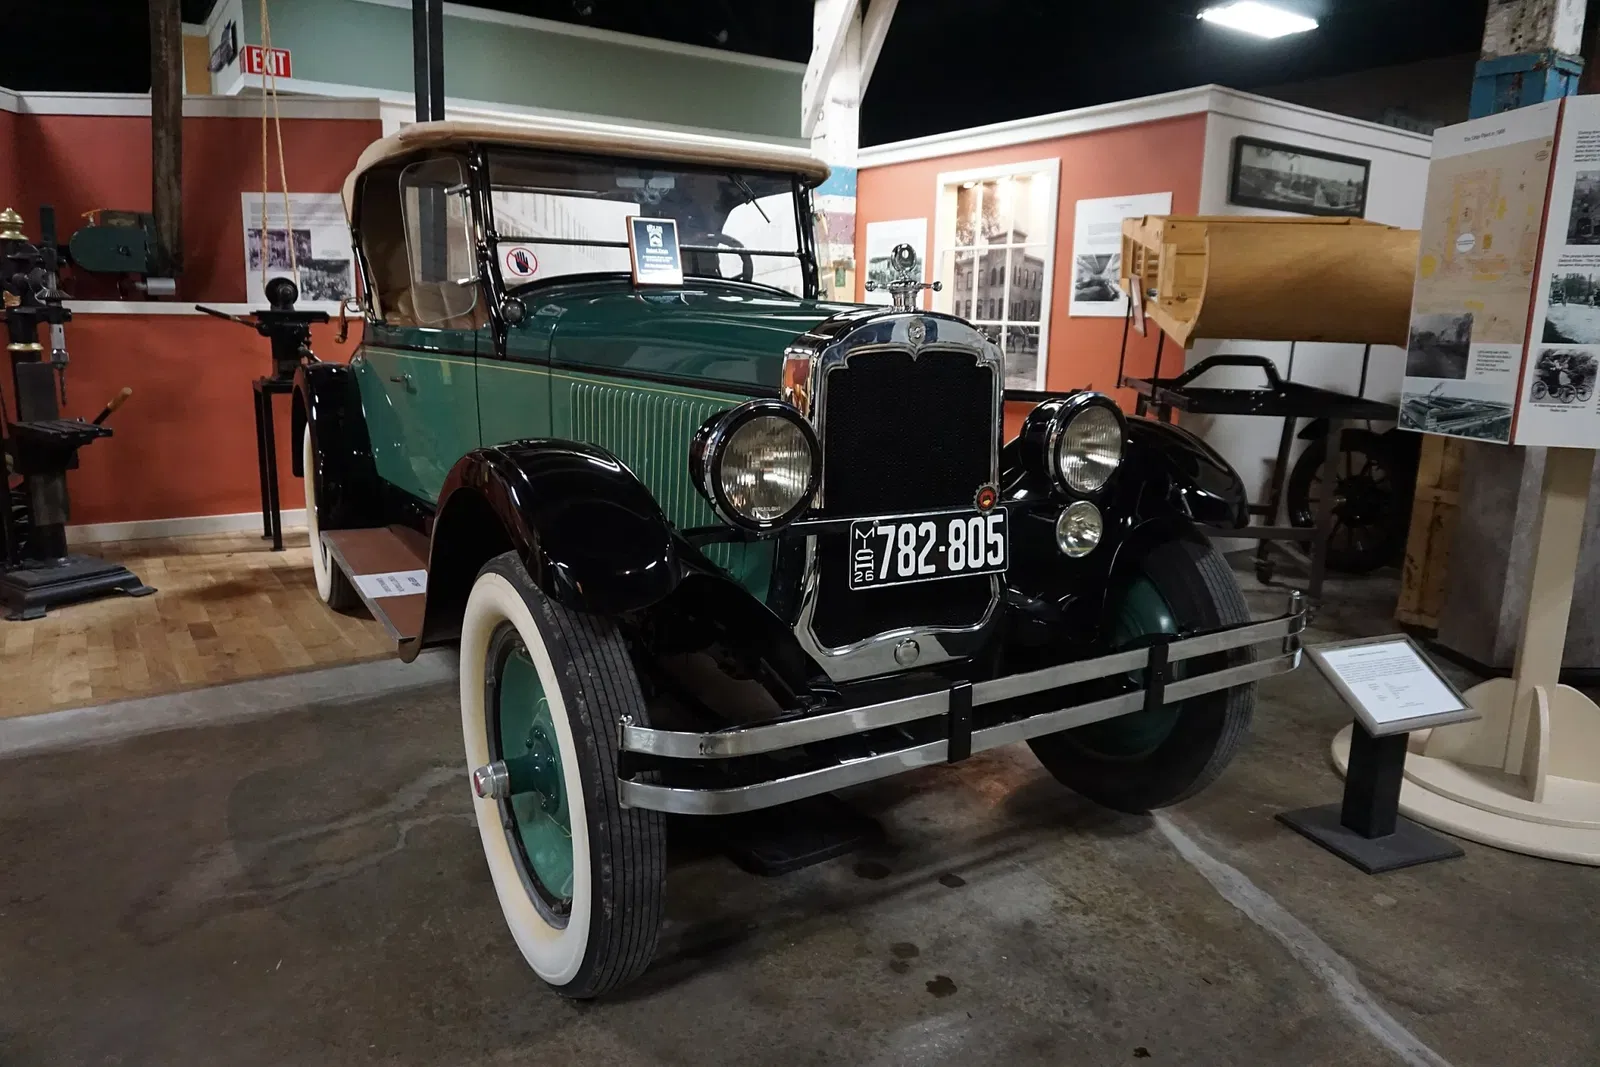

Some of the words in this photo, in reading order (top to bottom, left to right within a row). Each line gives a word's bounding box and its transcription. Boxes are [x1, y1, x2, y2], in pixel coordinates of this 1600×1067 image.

[253, 48, 286, 75] EXIT
[876, 514, 1004, 580] 782-805
[854, 570, 875, 583] 26
